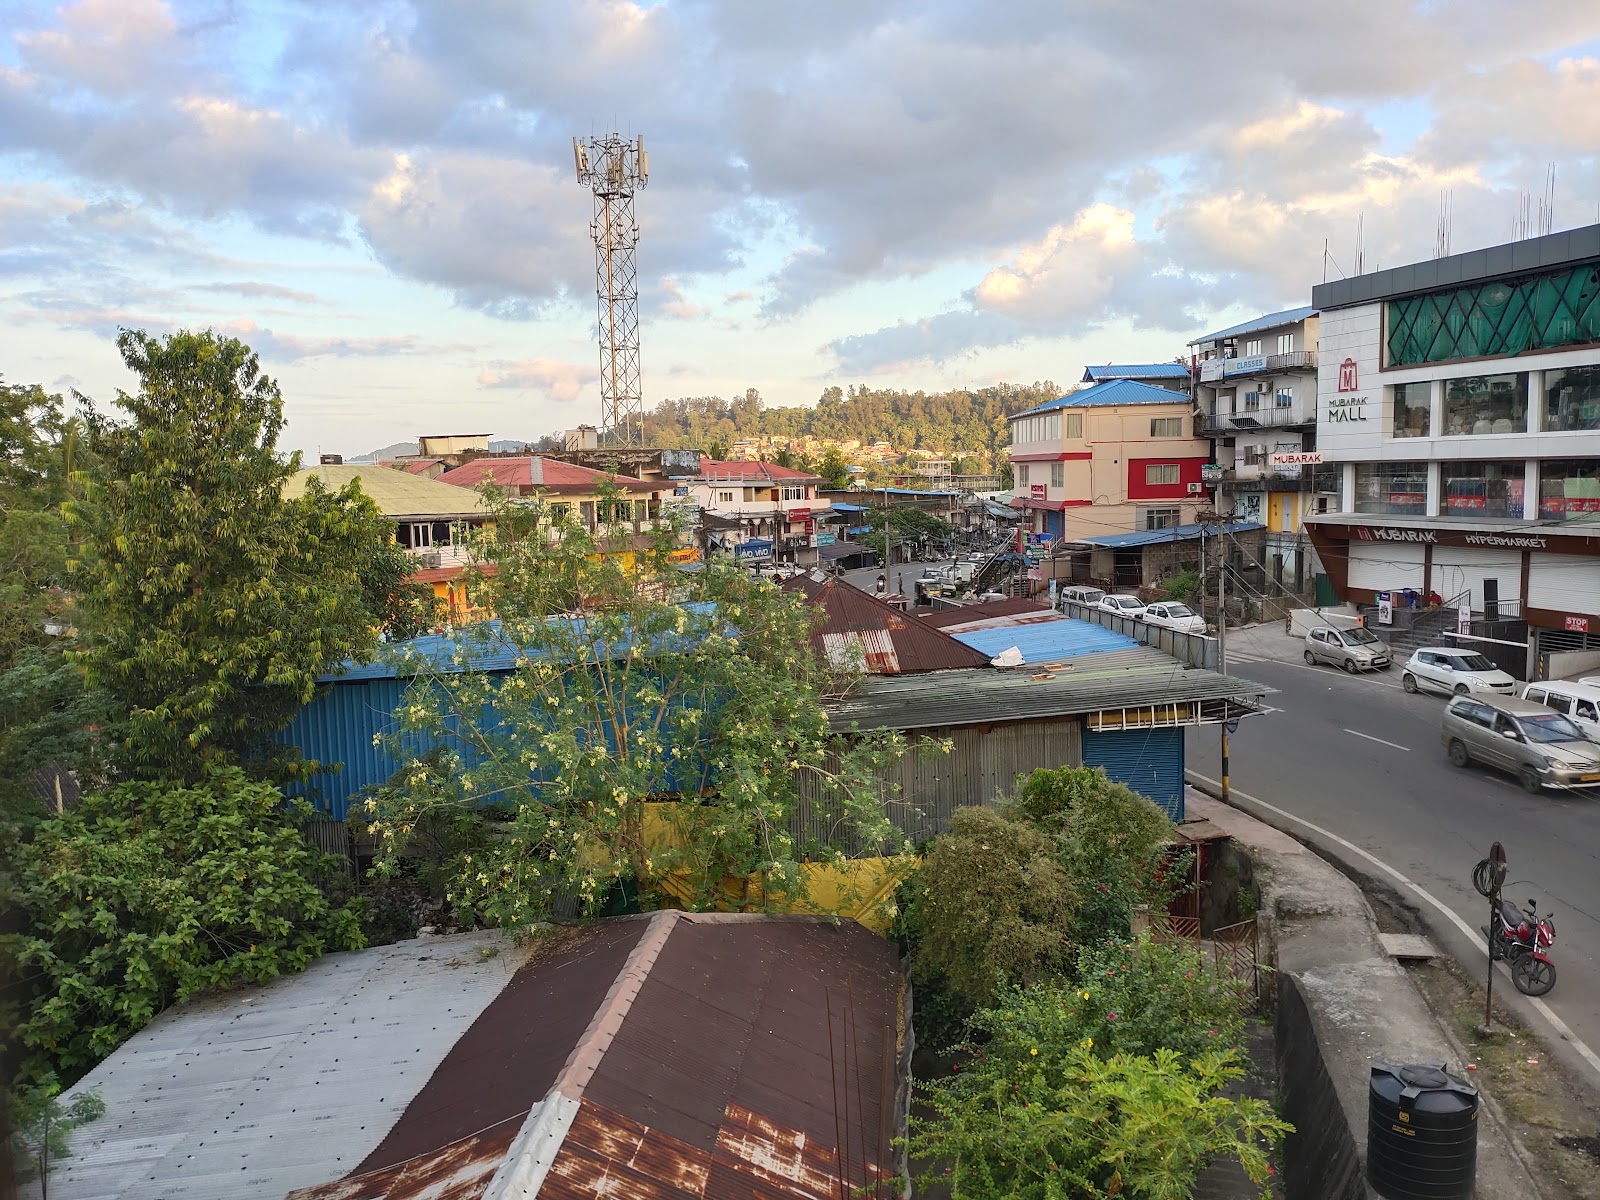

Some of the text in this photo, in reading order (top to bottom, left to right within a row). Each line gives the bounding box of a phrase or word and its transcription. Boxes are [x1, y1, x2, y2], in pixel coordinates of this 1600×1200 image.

[1237, 359, 1263, 369] CLASSES
[1329, 397, 1368, 407] MUBARAK
[1329, 407, 1367, 423] MALL
[1274, 454, 1321, 464] MUBARAK
[1373, 528, 1547, 549] MUBARAK HYPERMARKET
[1566, 616, 1587, 625] STOP
